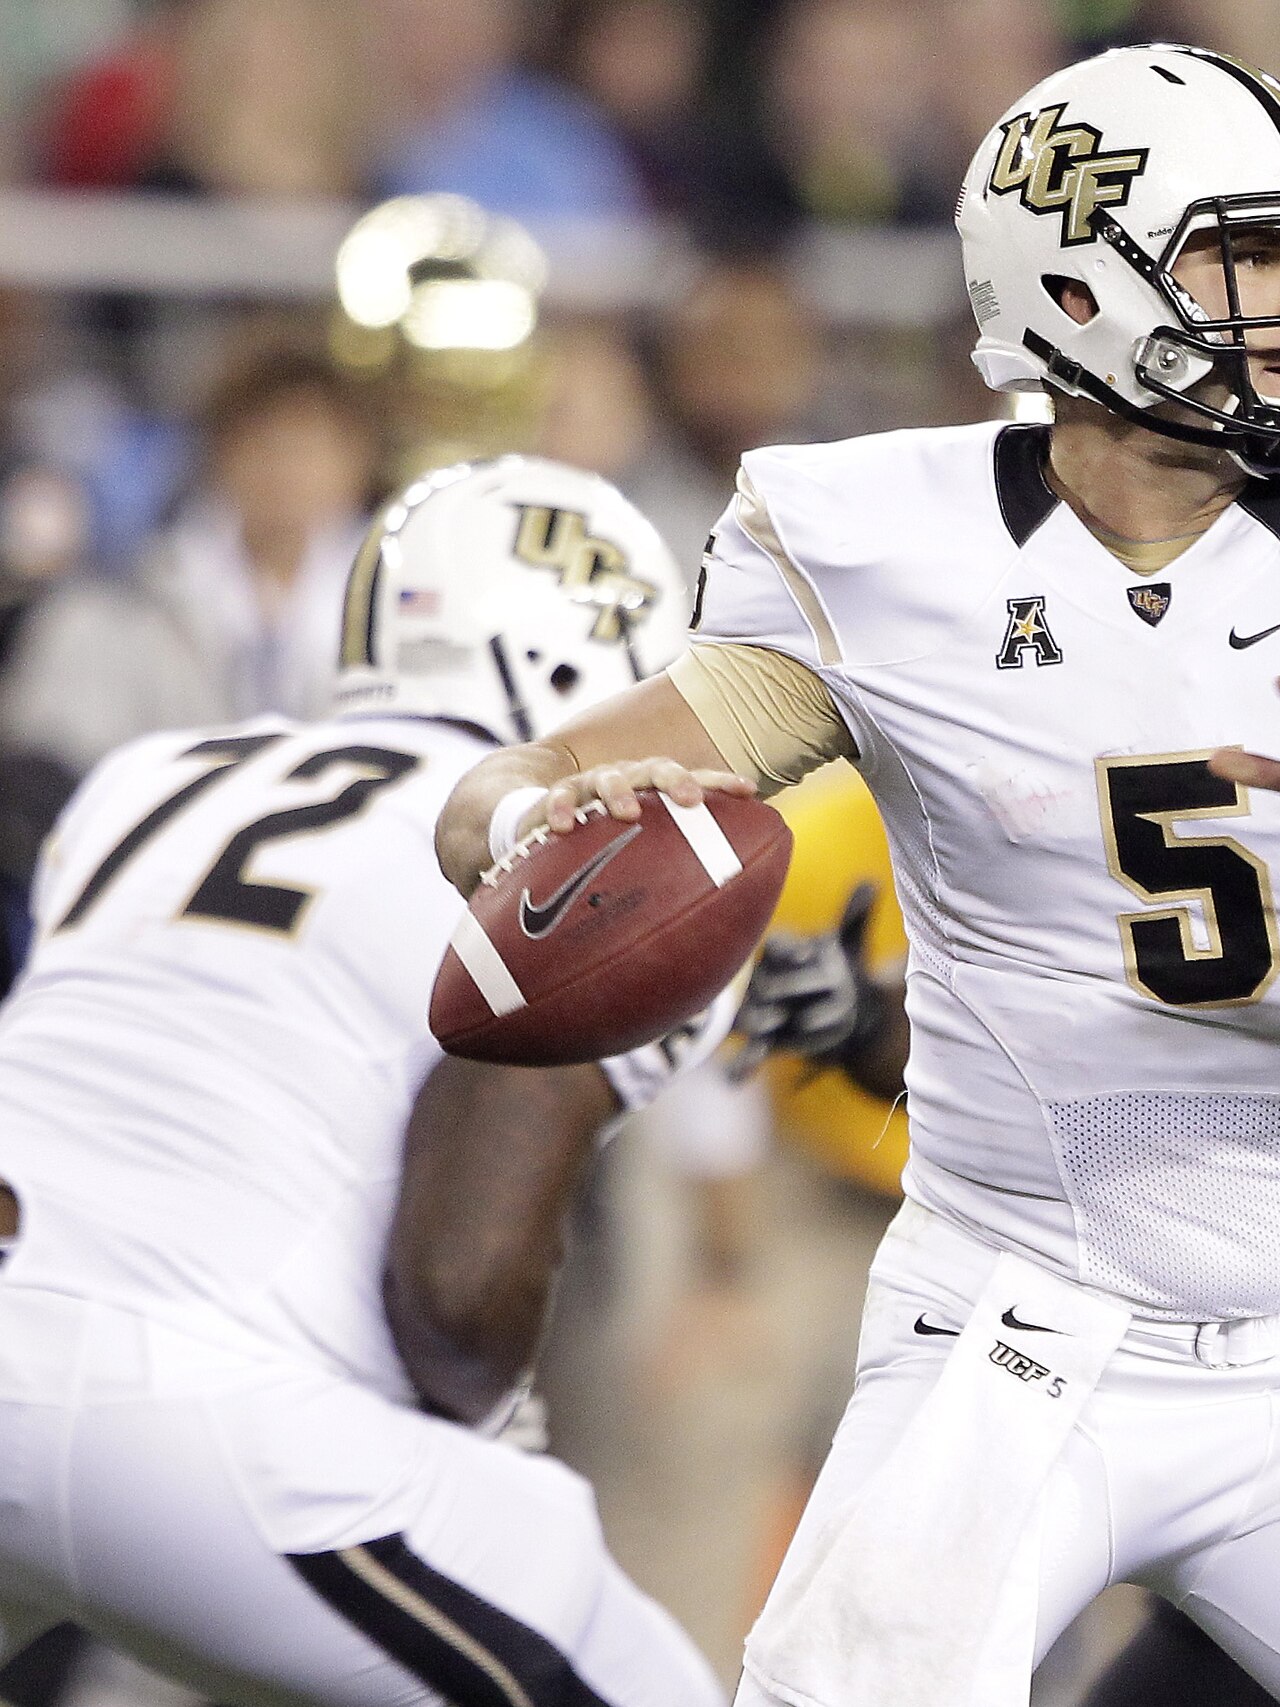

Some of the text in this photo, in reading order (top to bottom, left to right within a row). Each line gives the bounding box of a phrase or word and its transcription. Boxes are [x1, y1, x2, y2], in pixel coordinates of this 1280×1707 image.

[988, 101, 1150, 248] UCF
[509, 502, 659, 643] UCF
[1128, 589, 1169, 618] UCF
[52, 733, 424, 938] 72
[988, 1339, 1068, 1399] UCF 5
